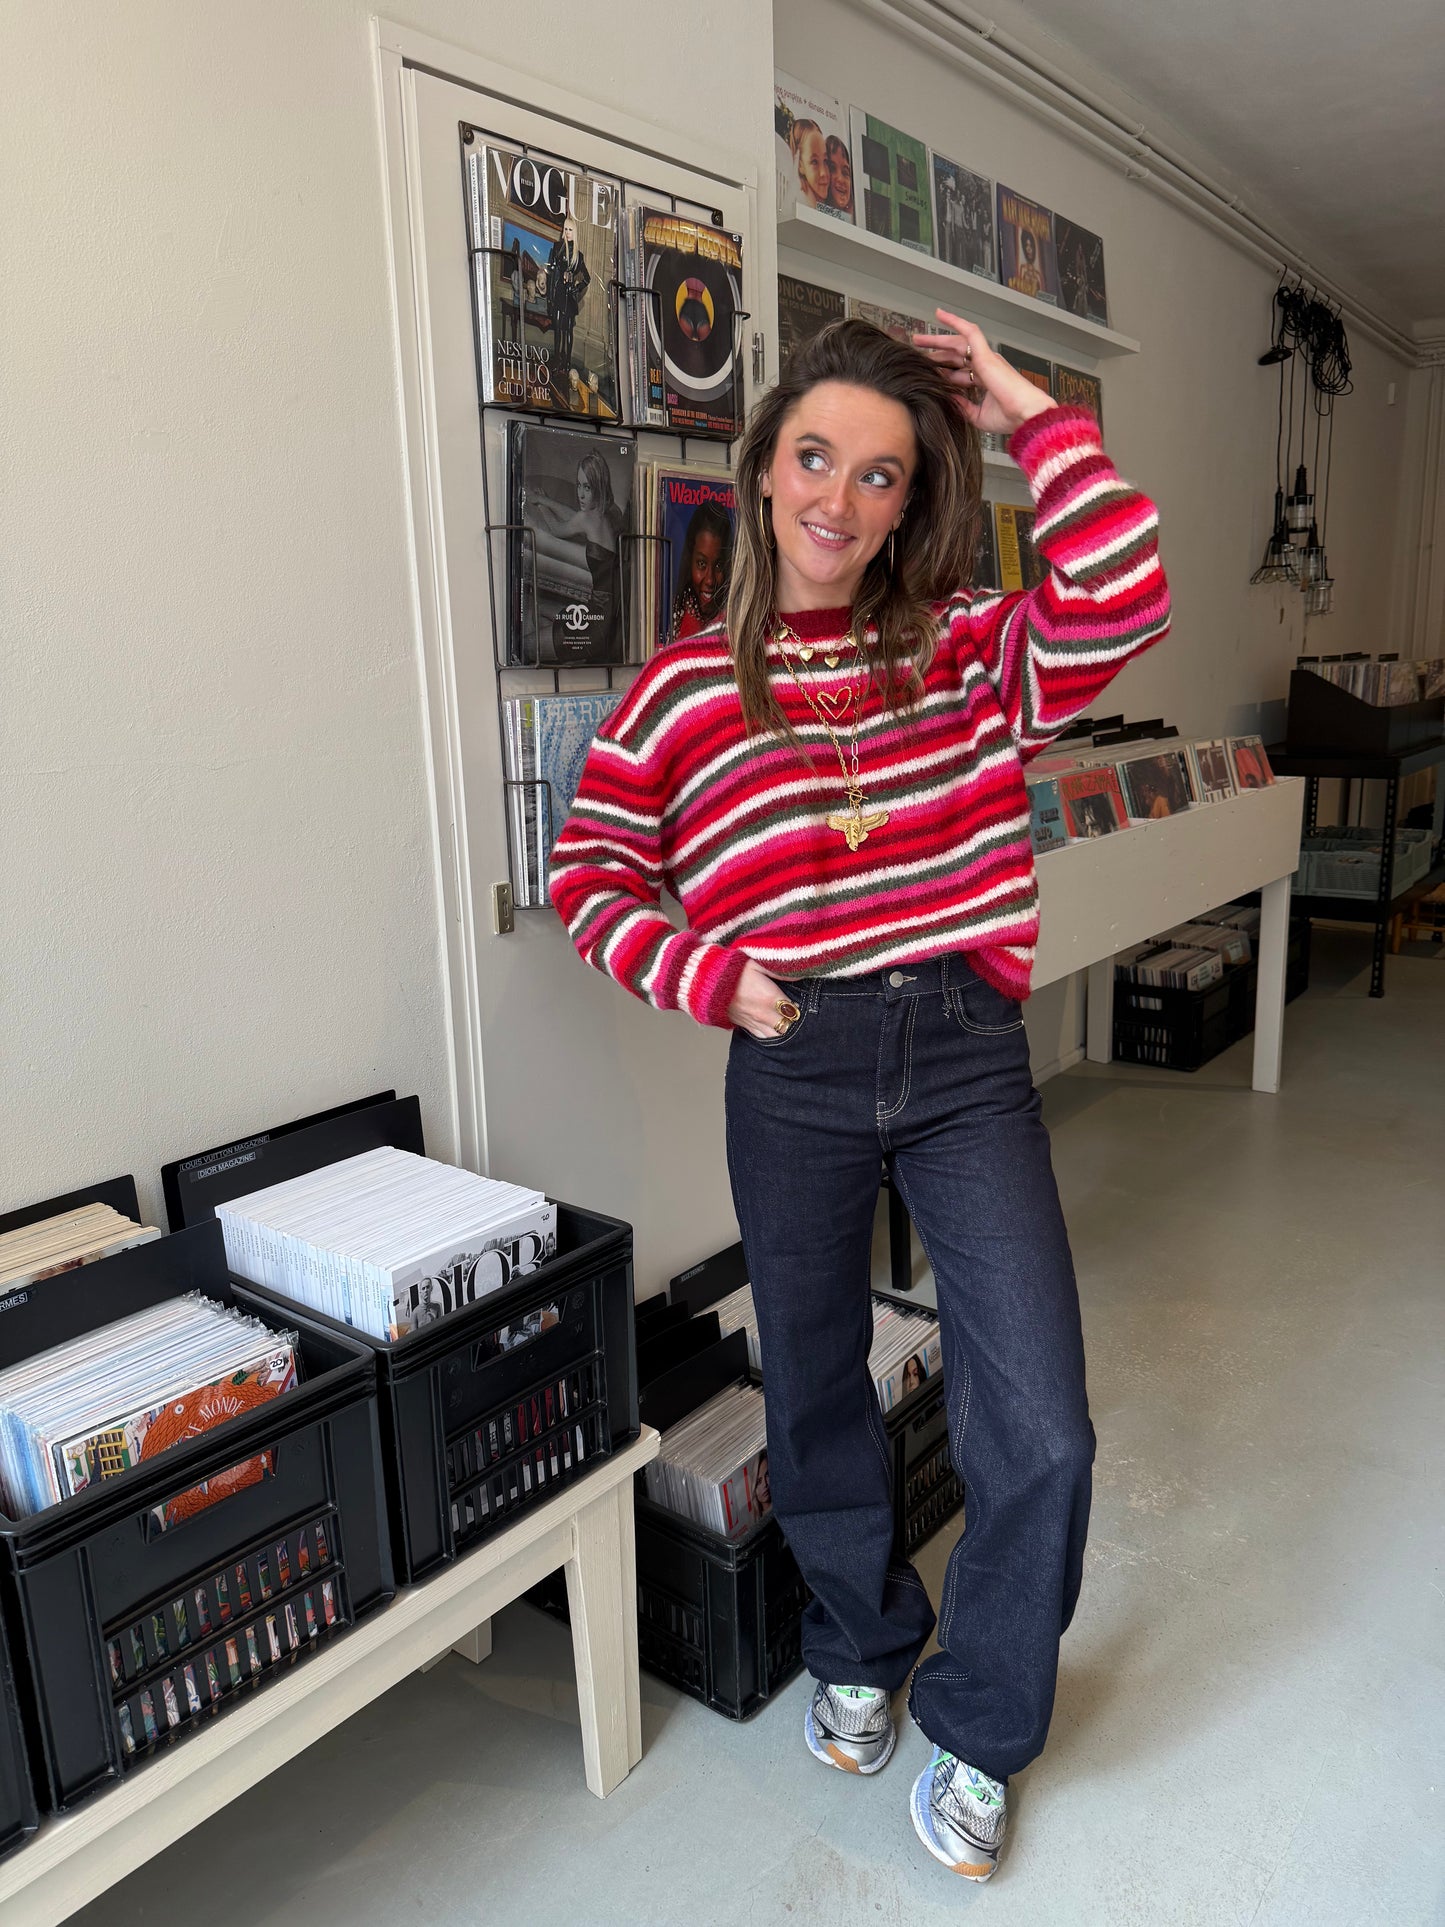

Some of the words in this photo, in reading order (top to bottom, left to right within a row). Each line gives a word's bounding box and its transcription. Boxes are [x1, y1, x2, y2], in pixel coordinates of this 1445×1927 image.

[488, 149, 615, 230] VOGUE
[181, 1159, 203, 1171] LOUIS
[203, 1148, 234, 1163] VUITTON
[234, 1135, 269, 1151] MAGAZINE
[199, 1166, 217, 1178] DIOR
[218, 1154, 254, 1171] MAGAZINE
[401, 1231, 544, 1316] DIOR
[271, 1359, 282, 1368] 20
[199, 1396, 246, 1423] MONDE
